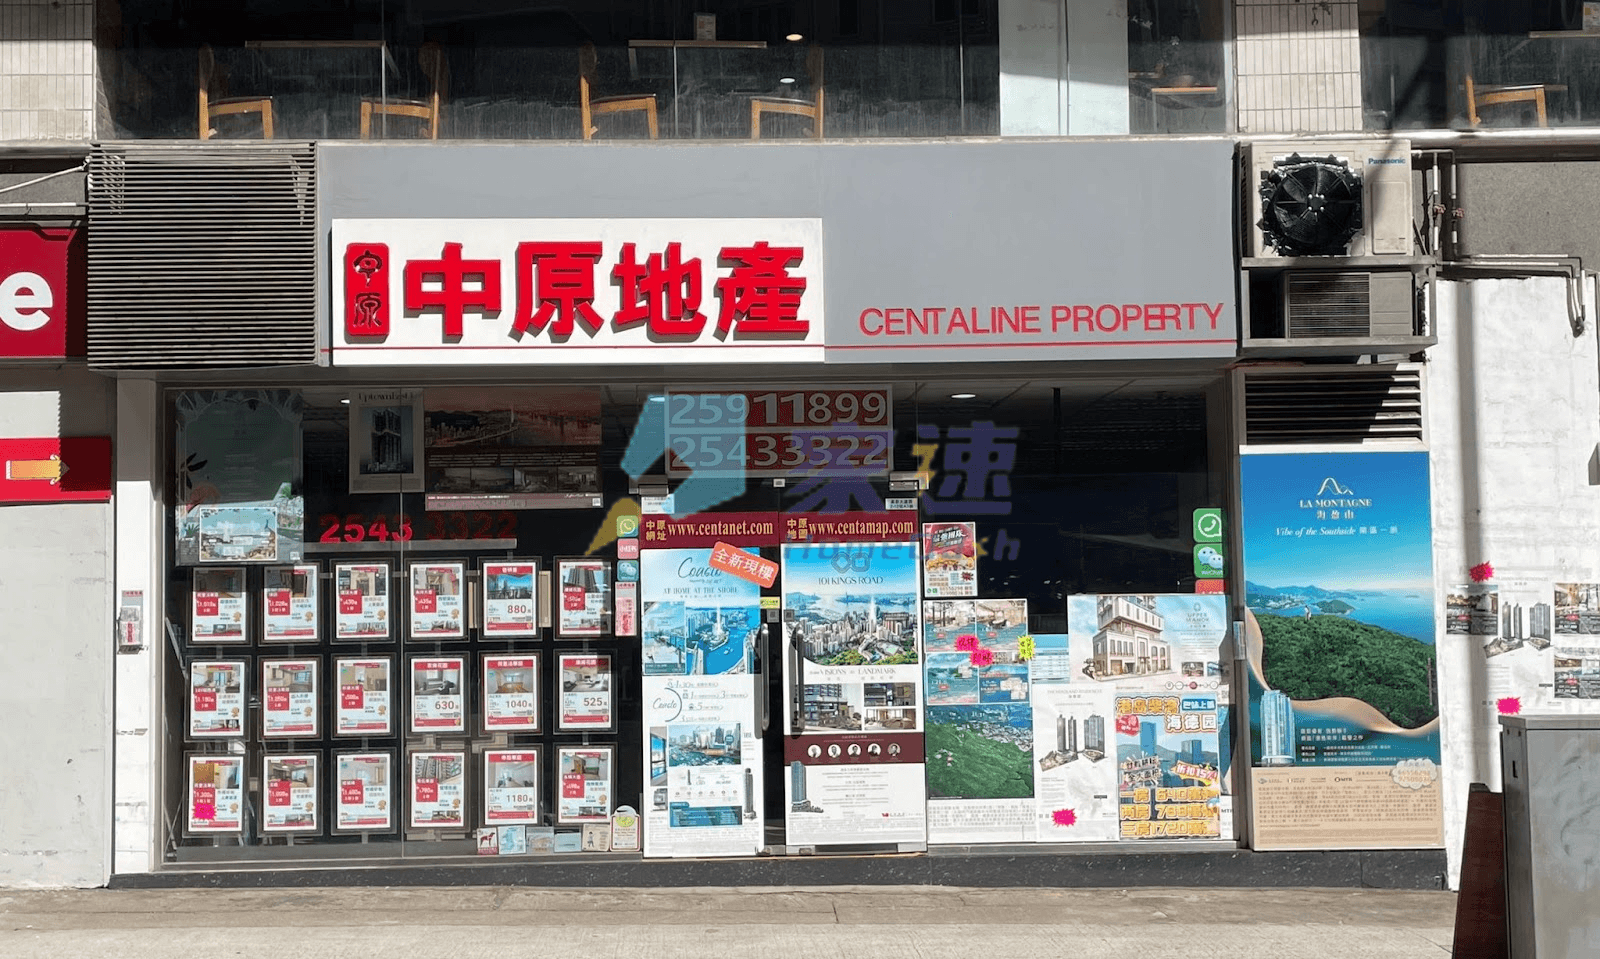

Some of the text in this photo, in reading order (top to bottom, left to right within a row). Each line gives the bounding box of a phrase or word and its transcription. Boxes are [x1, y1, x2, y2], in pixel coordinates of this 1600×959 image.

[0, 271, 54, 331] e
[406, 241, 810, 339] 中原地產
[859, 302, 1224, 338] CENTALINE PROPERTY
[670, 391, 887, 425] 25911899
[670, 434, 888, 468] 25433322
[1299, 498, 1372, 508] LA MONTAGNE
[319, 516, 414, 545] 2543
[645, 520, 667, 530] 中原
[667, 521, 774, 536] www.centanet.com
[786, 518, 808, 529] 中原
[808, 520, 915, 538] www.centamap.com
[1275, 526, 1293, 536] Vibe
[1294, 526, 1305, 538] of
[1306, 526, 1318, 536] the
[1319, 526, 1356, 536] Southside
[713, 548, 775, 582] 全新現樓
[831, 577, 857, 585] KINGS
[858, 576, 884, 585] ROAD
